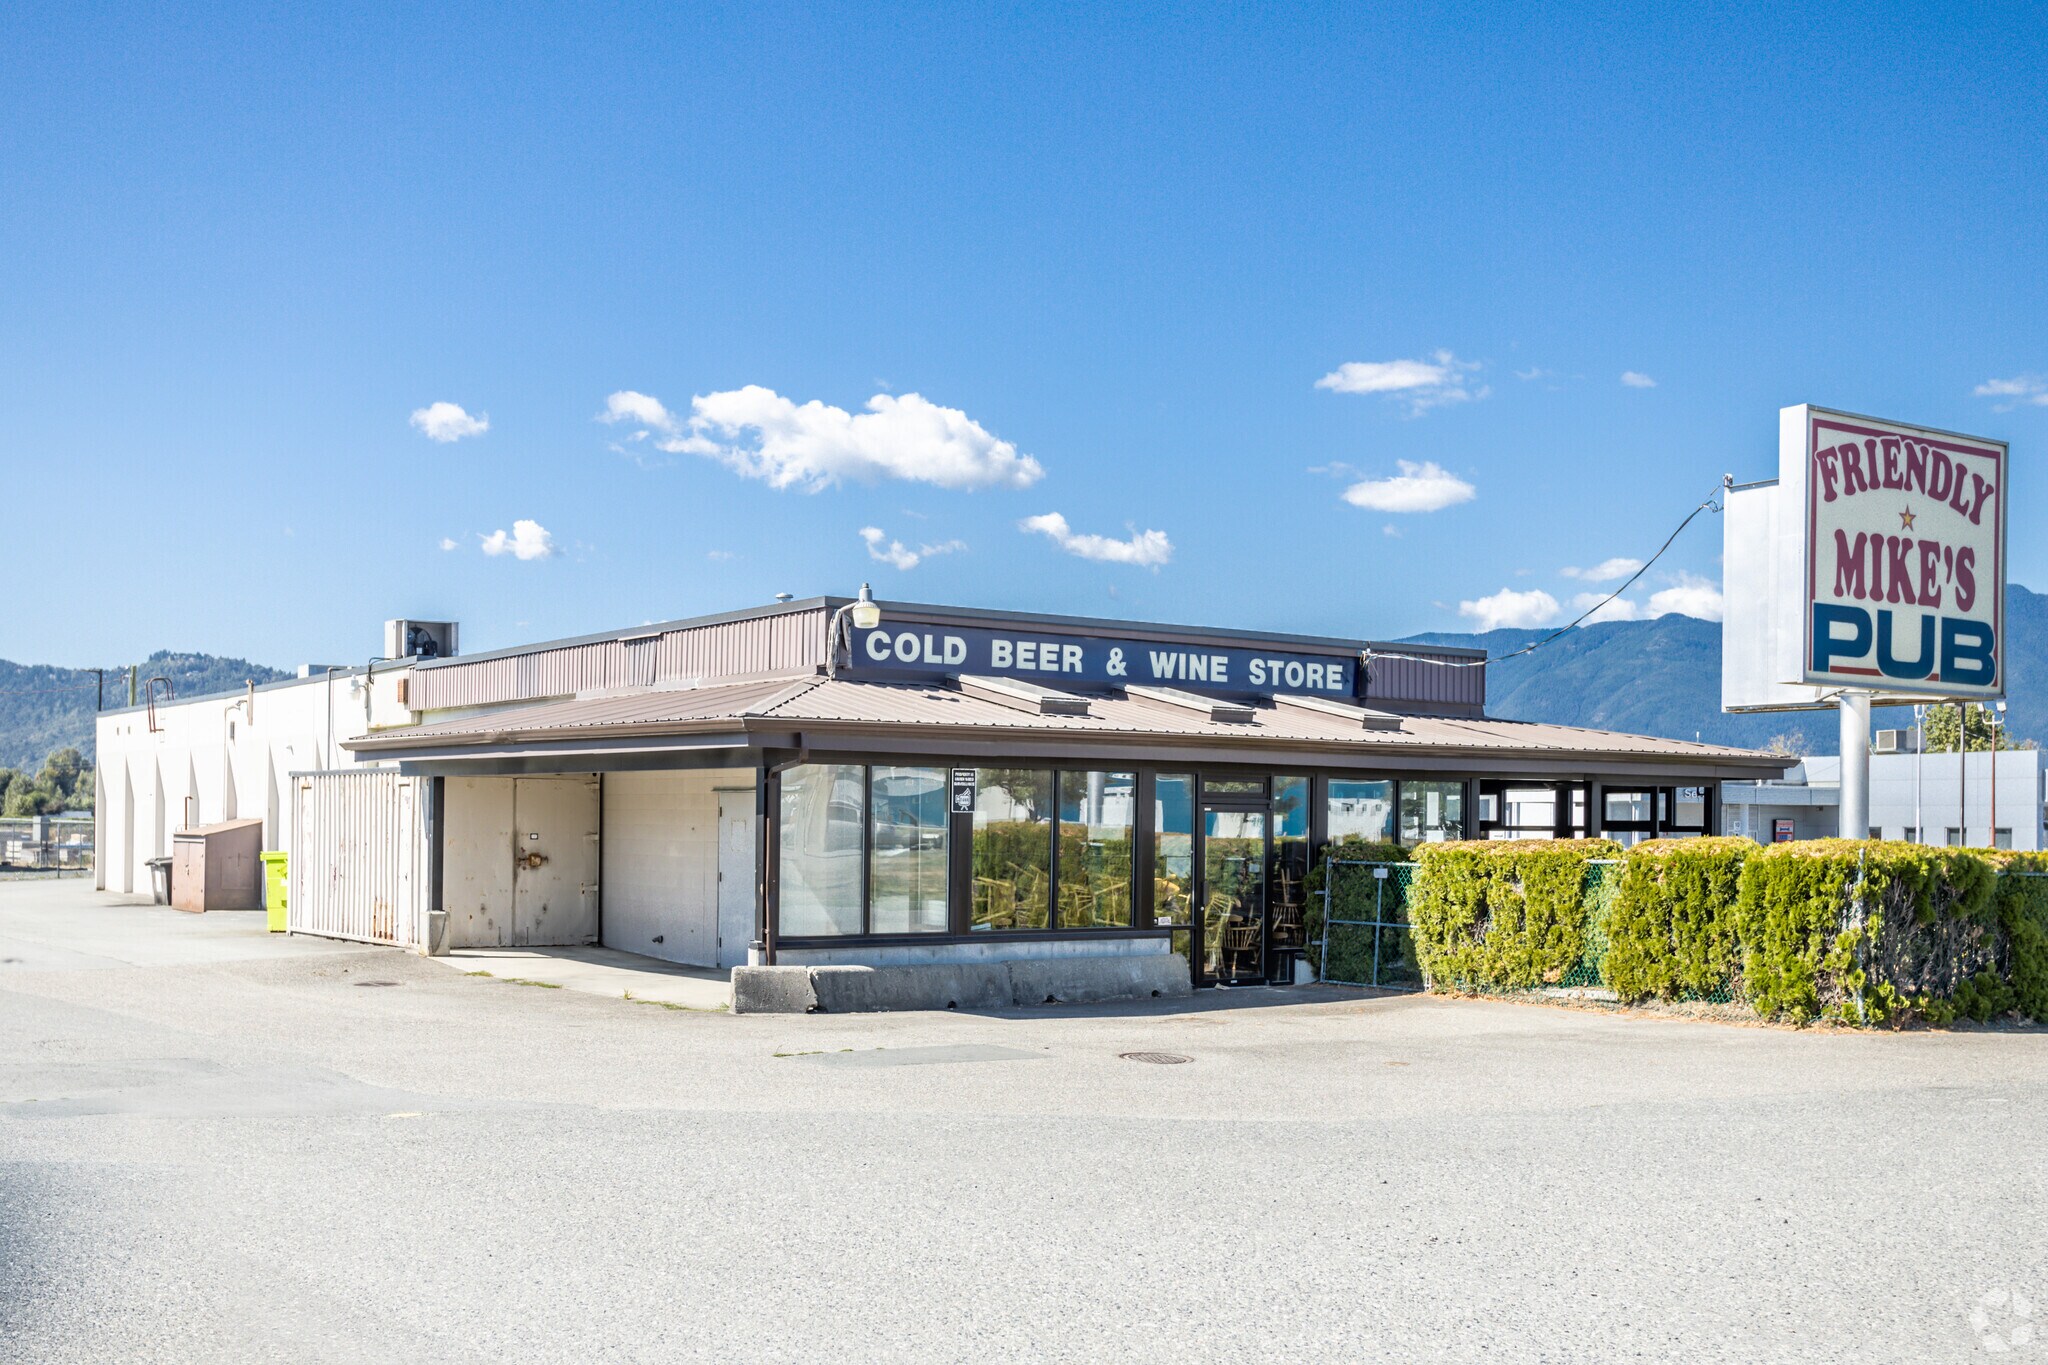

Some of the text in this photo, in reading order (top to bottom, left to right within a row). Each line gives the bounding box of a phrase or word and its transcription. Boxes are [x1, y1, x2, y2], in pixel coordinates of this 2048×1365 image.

[1816, 438, 1994, 525] FRIENDLY
[1834, 528, 1976, 612] MIKE'S
[866, 631, 1343, 690] COLD BEER & WINE STORE
[1812, 603, 1996, 687] PUB
